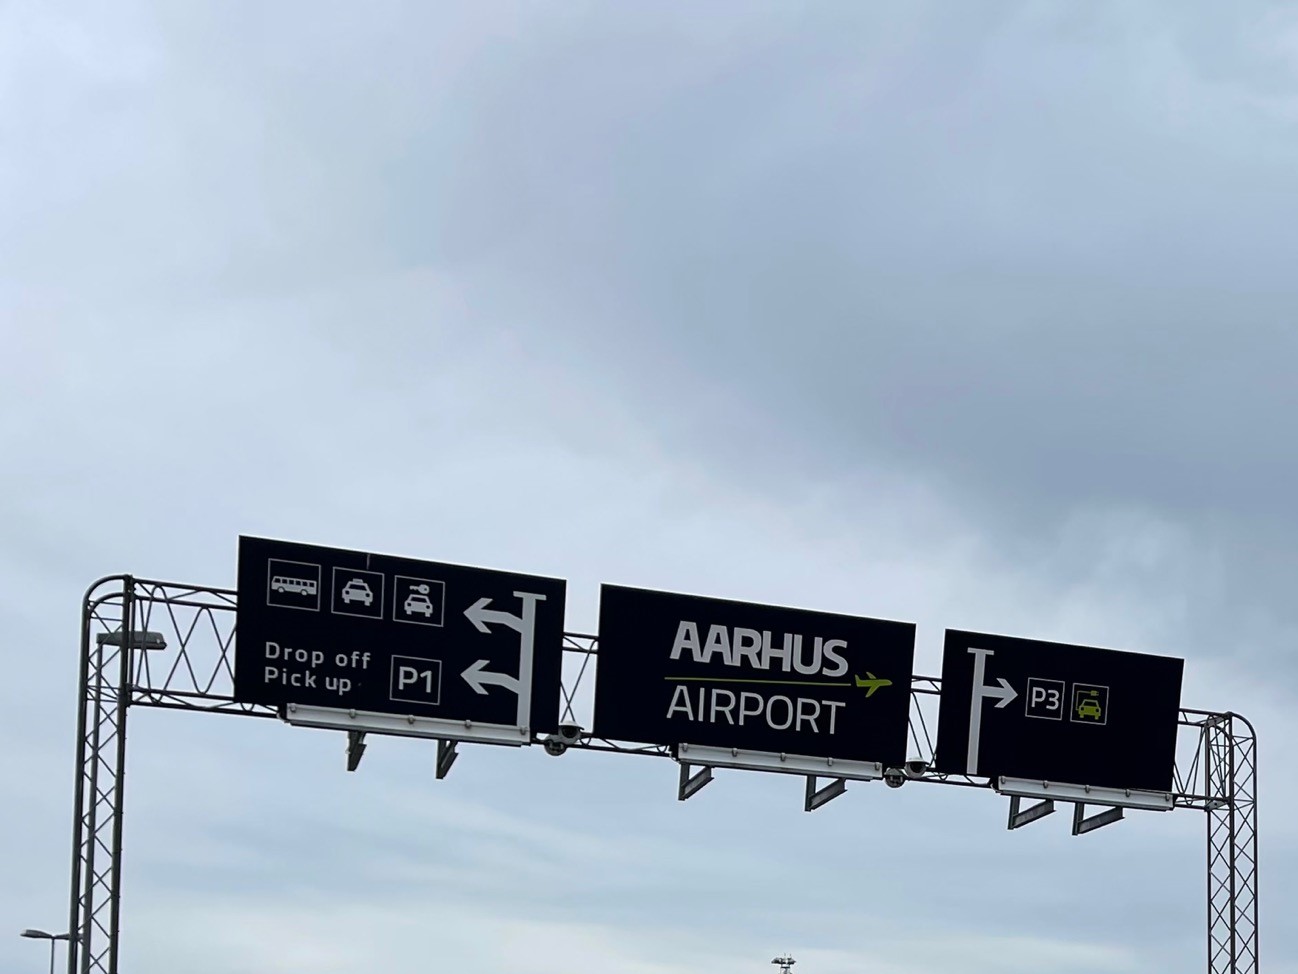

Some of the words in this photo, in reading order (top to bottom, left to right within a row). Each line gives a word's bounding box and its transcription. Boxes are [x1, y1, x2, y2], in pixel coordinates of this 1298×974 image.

[265, 641, 324, 668] Drop
[335, 651, 371, 669] off
[669, 621, 849, 677] AARHUS
[264, 666, 317, 688] Pick
[325, 676, 352, 696] up
[398, 666, 433, 693] P1
[666, 685, 846, 735] AIRPORT
[1031, 686, 1060, 711] P3
